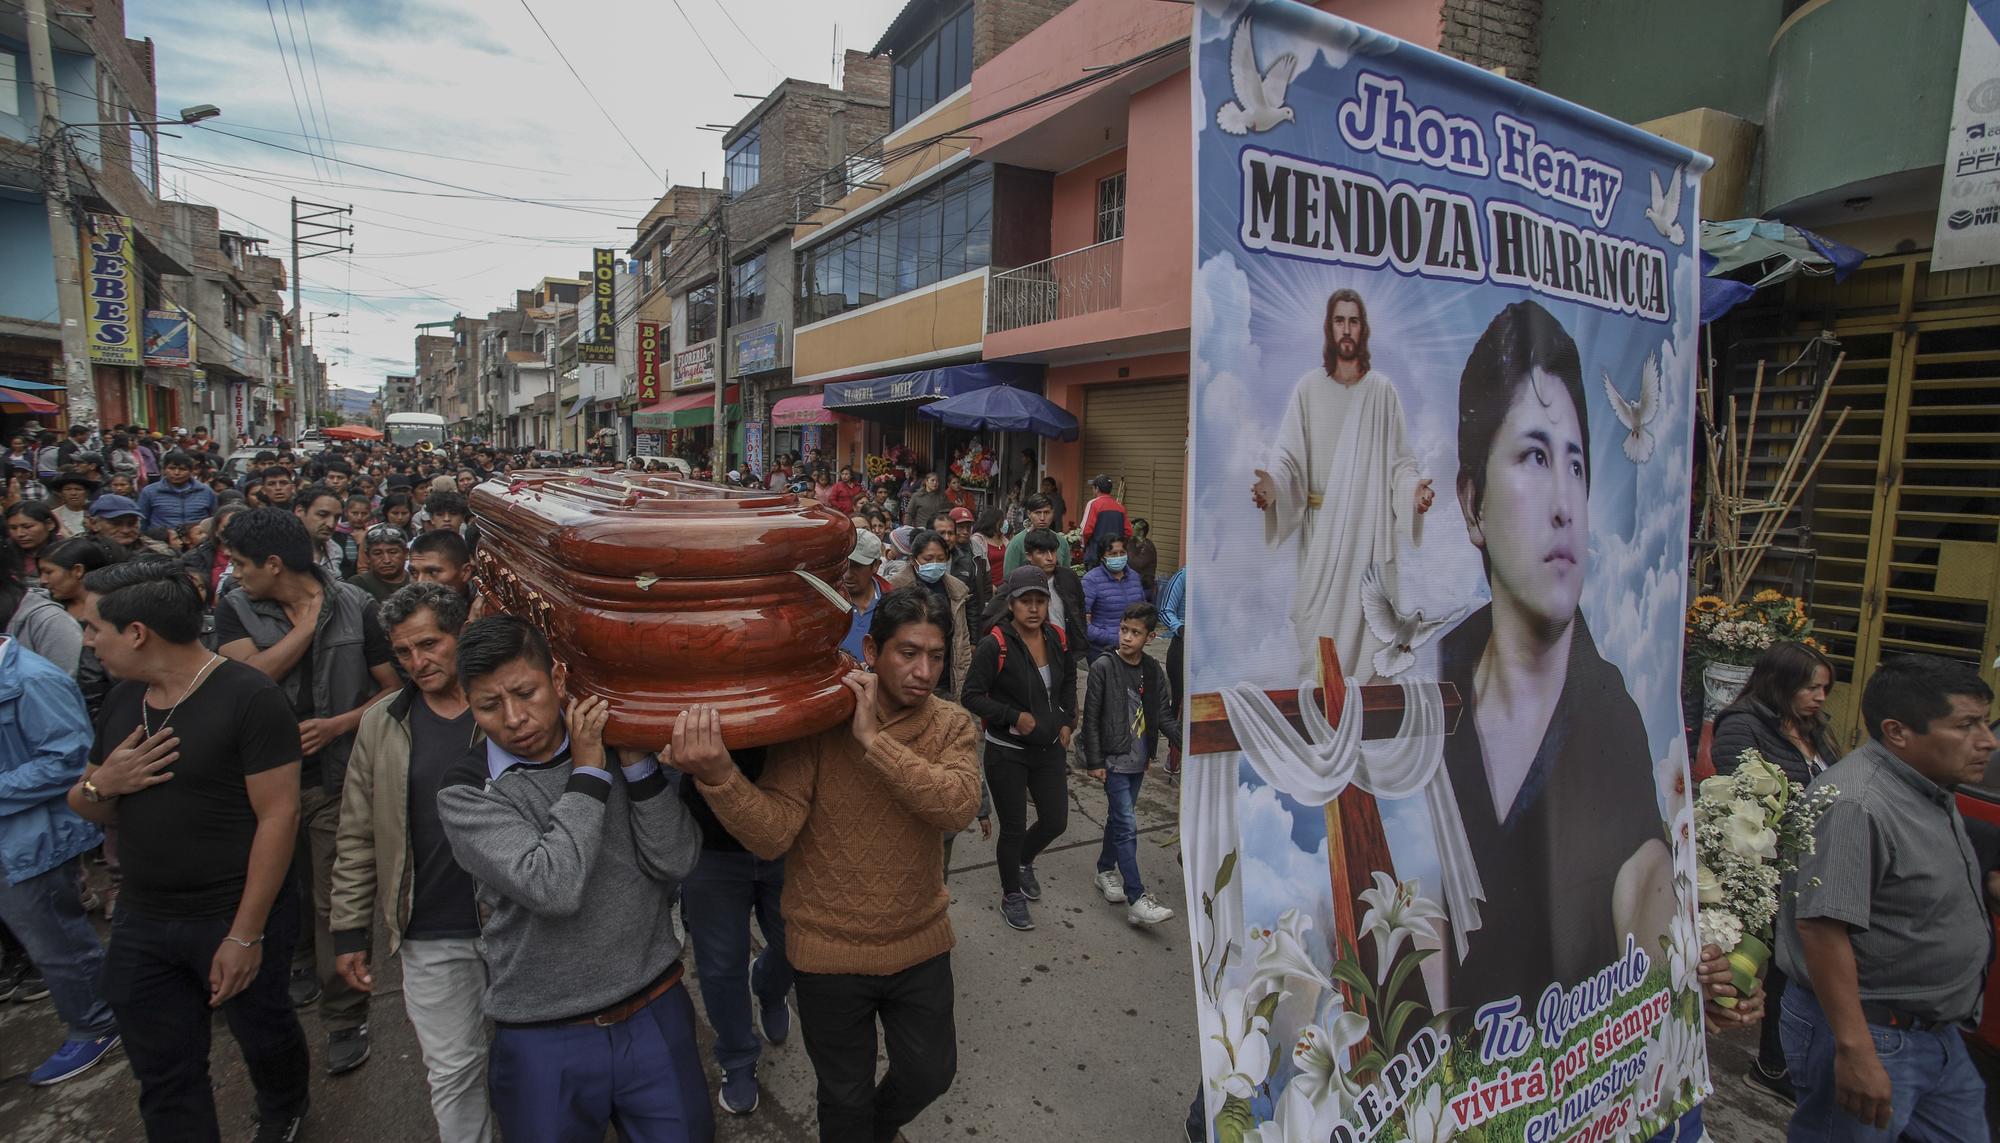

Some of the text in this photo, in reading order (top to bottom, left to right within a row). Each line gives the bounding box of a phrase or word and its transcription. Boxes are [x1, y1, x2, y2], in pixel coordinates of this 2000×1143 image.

[1343, 81, 1621, 221] Jhon Henry
[90, 233, 128, 345] JEBES
[1248, 159, 1666, 315] MENDOZA HUARANCCA
[596, 251, 614, 340] HOSTAL
[235, 383, 244, 438] VIDRIERI
[641, 326, 656, 399] BOTICA
[1476, 937, 1649, 1060] Tu Recuerdo
[1451, 990, 1670, 1126] vivirá por siempre
[1527, 1049, 1648, 1143] en nuestros
